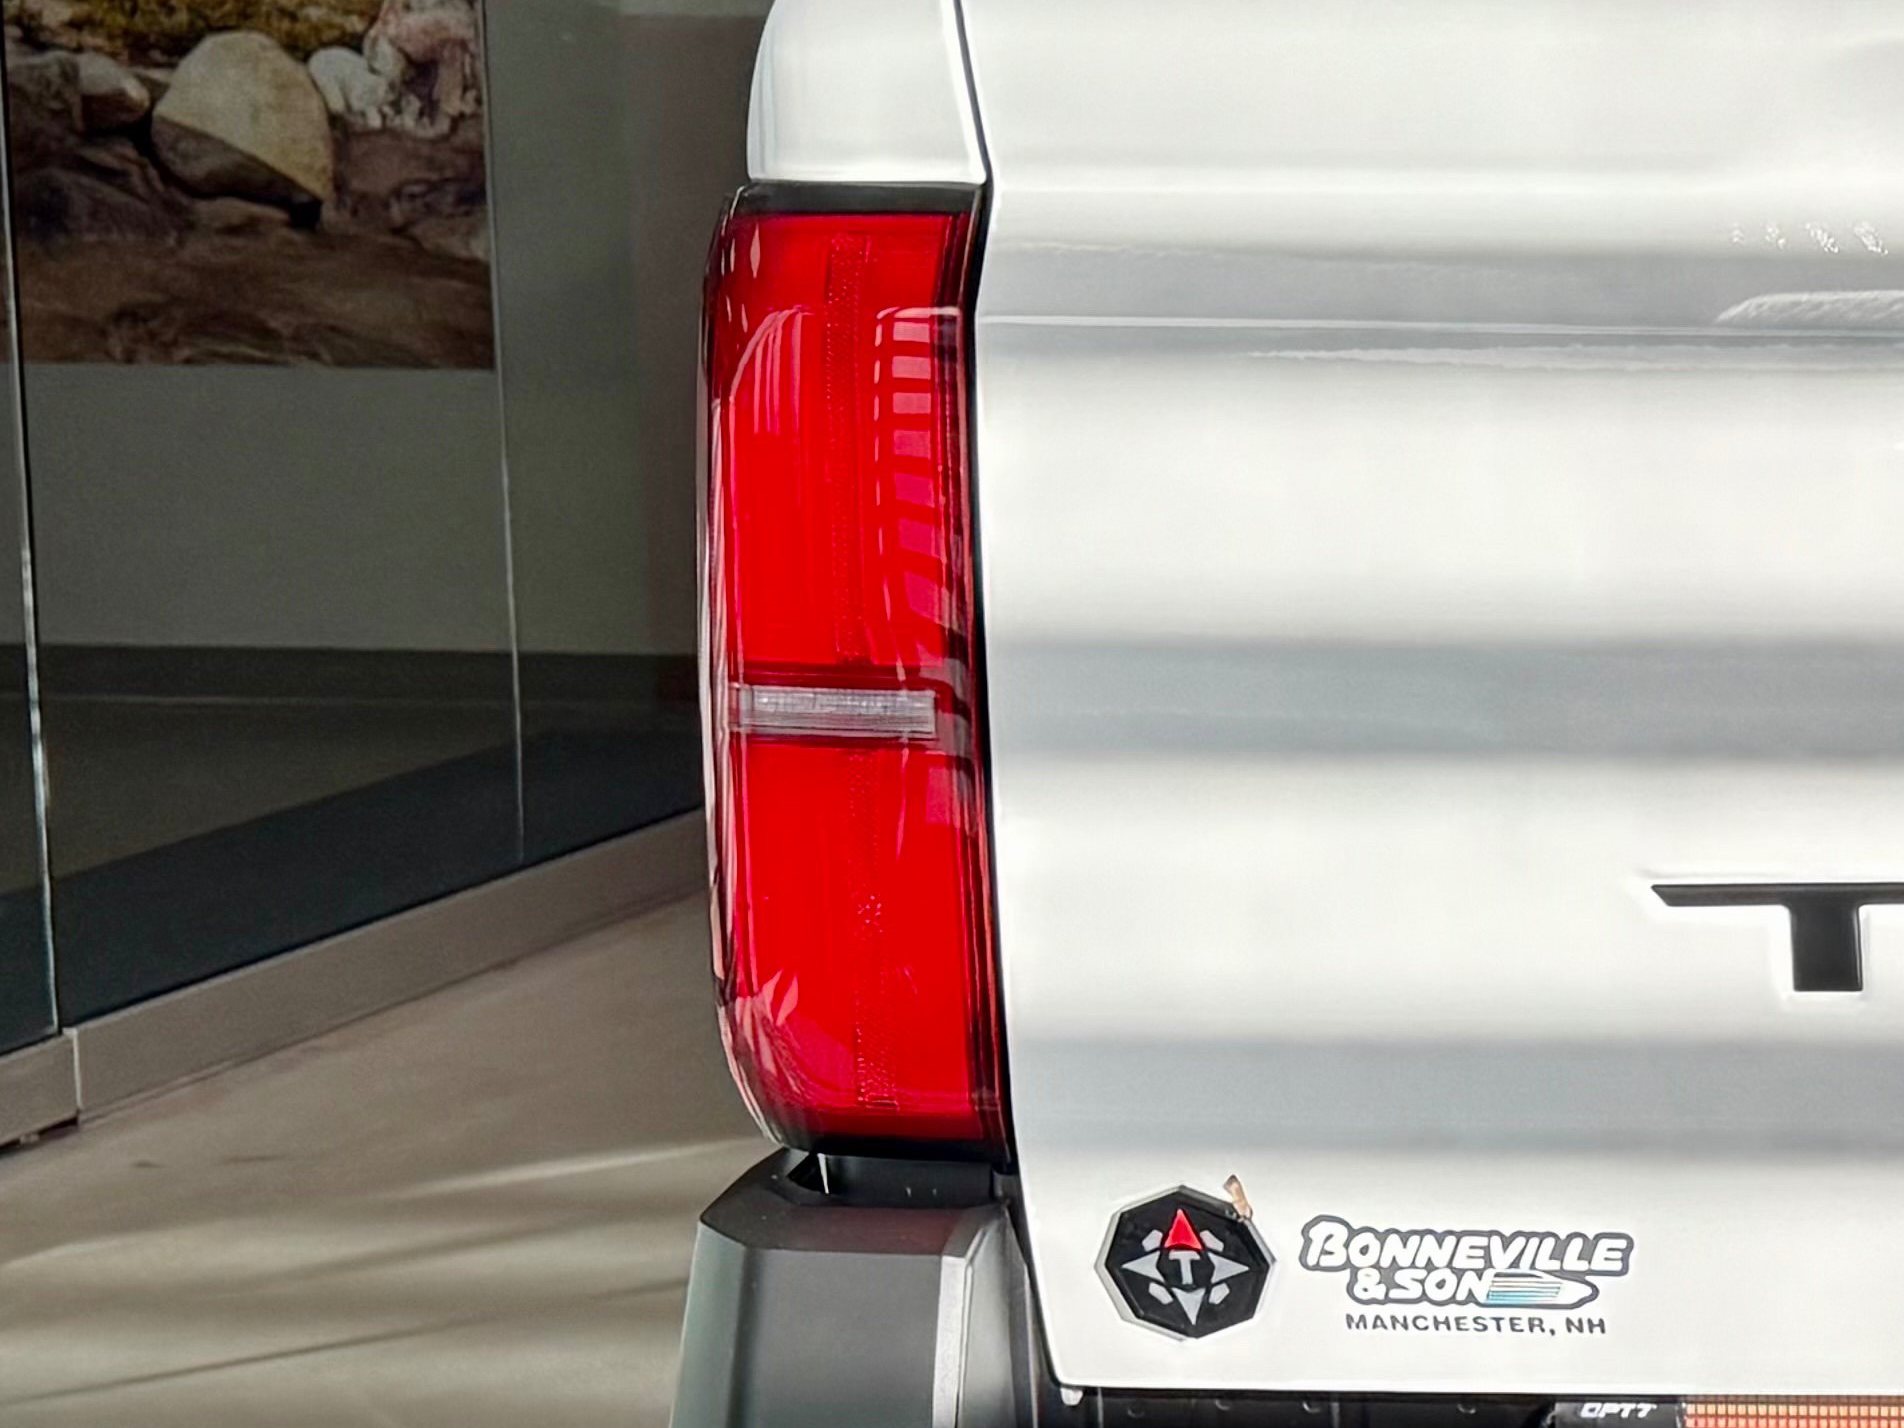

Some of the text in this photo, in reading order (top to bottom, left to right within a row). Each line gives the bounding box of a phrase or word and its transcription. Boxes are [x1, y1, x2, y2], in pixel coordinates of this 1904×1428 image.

[1303, 1218, 1632, 1274] BONNEVILLE
[1345, 1312, 1607, 1337] MANCHESTER, NH
